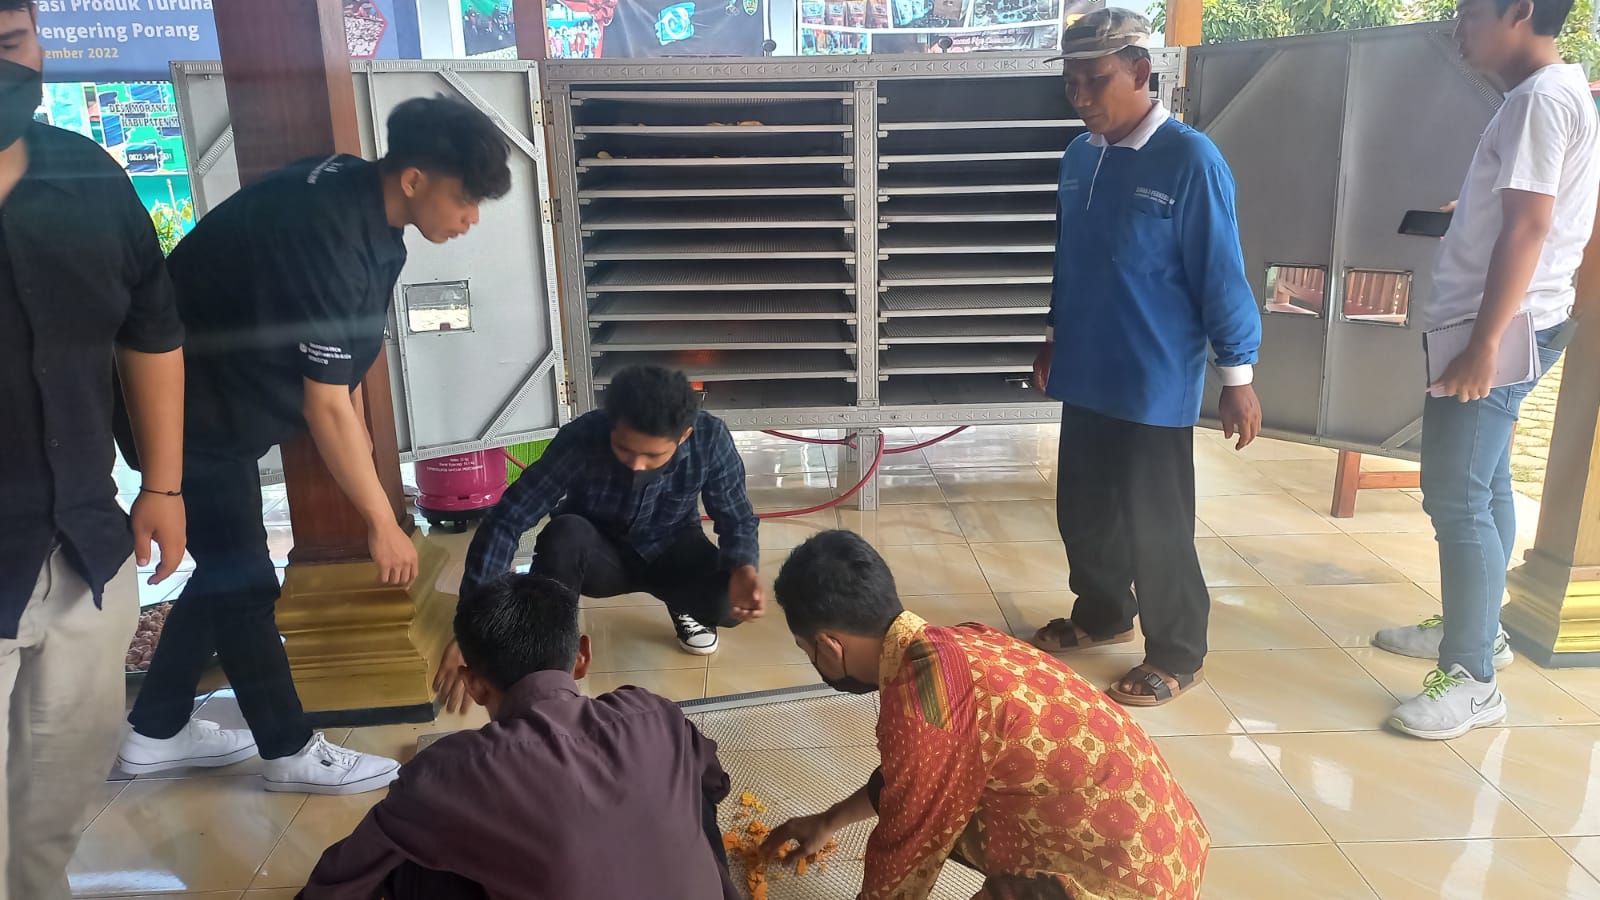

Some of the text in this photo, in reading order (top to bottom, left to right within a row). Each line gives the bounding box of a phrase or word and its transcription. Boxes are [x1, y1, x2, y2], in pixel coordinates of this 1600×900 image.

[33, 0, 65, 12] asi
[71, 0, 141, 12] Produk
[131, 23, 200, 41] Porang
[88, 47, 119, 59] 2022
